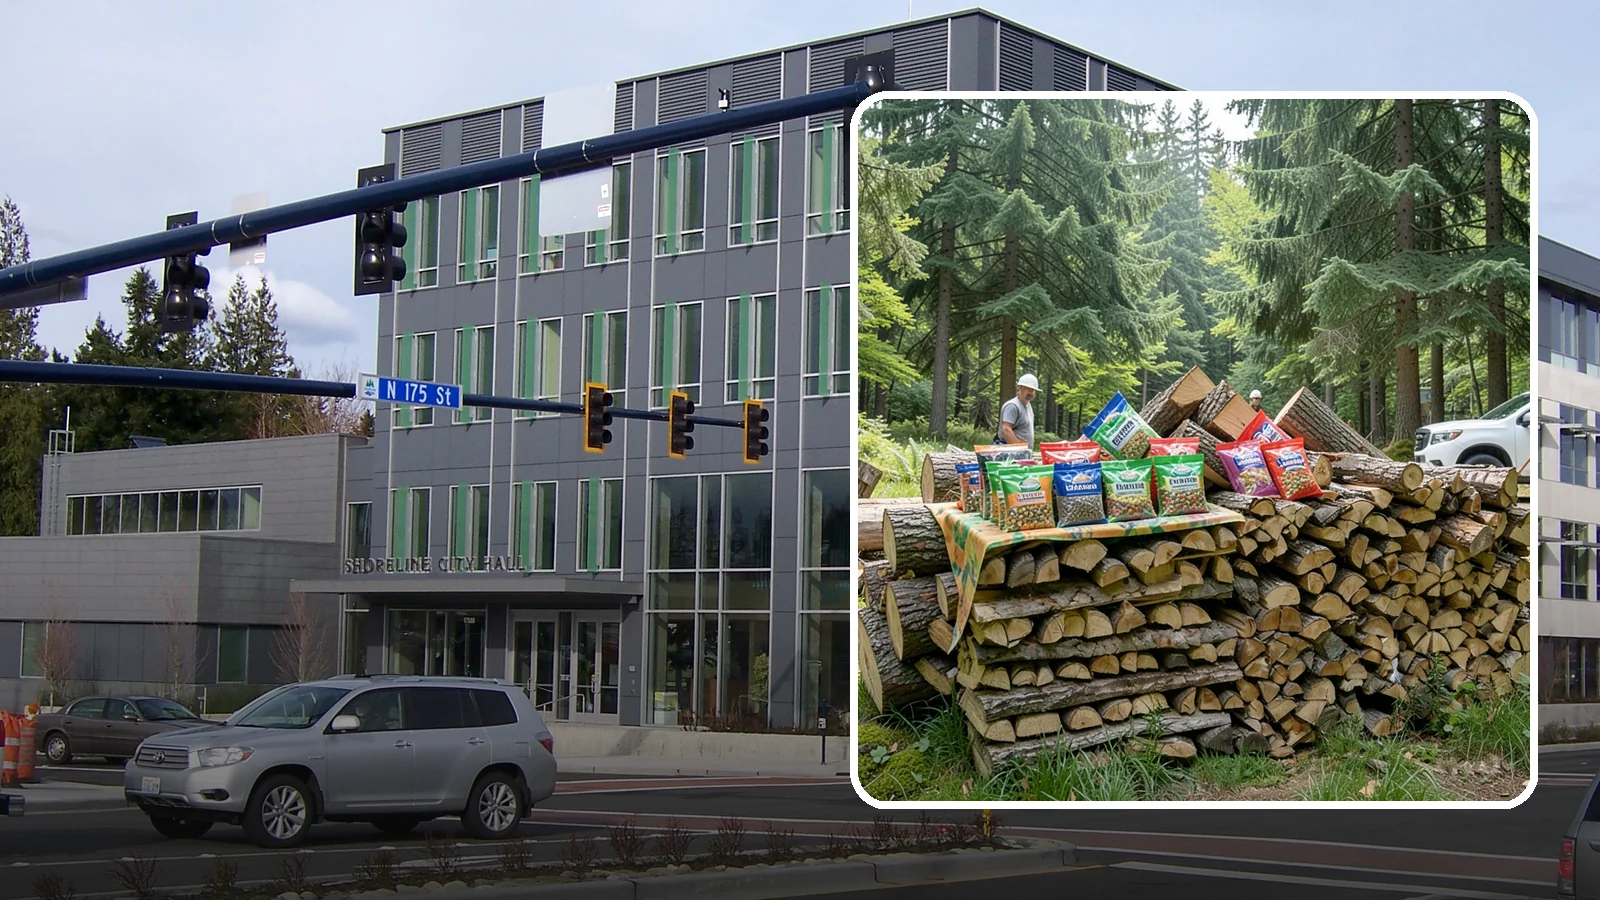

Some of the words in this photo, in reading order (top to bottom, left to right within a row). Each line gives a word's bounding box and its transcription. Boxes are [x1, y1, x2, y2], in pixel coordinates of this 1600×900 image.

[387, 380, 396, 400] N
[405, 382, 427, 403] 175
[436, 386, 451, 406] St
[344, 556, 432, 574] SHORELINE
[438, 556, 476, 573] CITY
[484, 555, 526, 572] HALL
